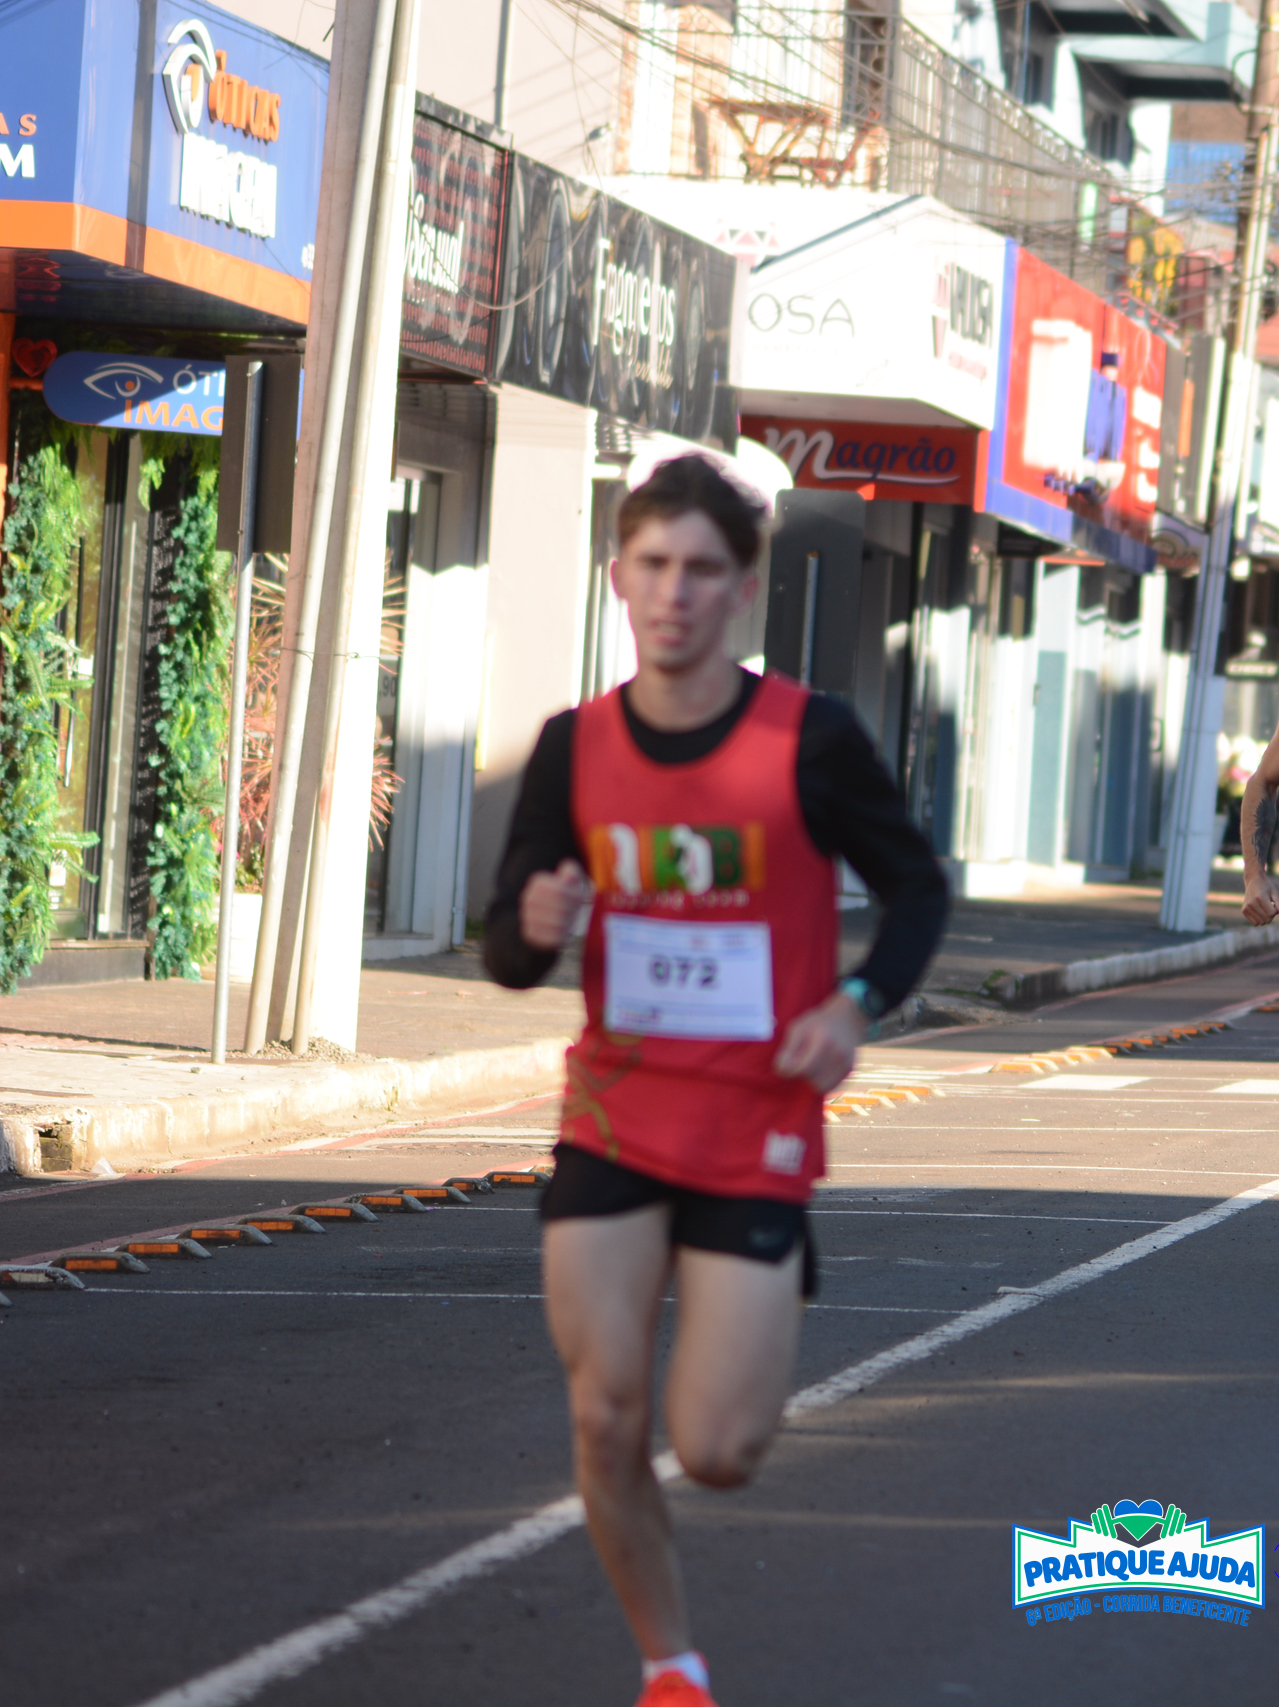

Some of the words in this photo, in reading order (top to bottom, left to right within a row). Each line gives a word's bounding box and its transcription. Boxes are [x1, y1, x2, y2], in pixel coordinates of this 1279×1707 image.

[124, 399, 224, 431] IMAG
[764, 427, 961, 485] Magrão
[651, 954, 719, 990] 072
